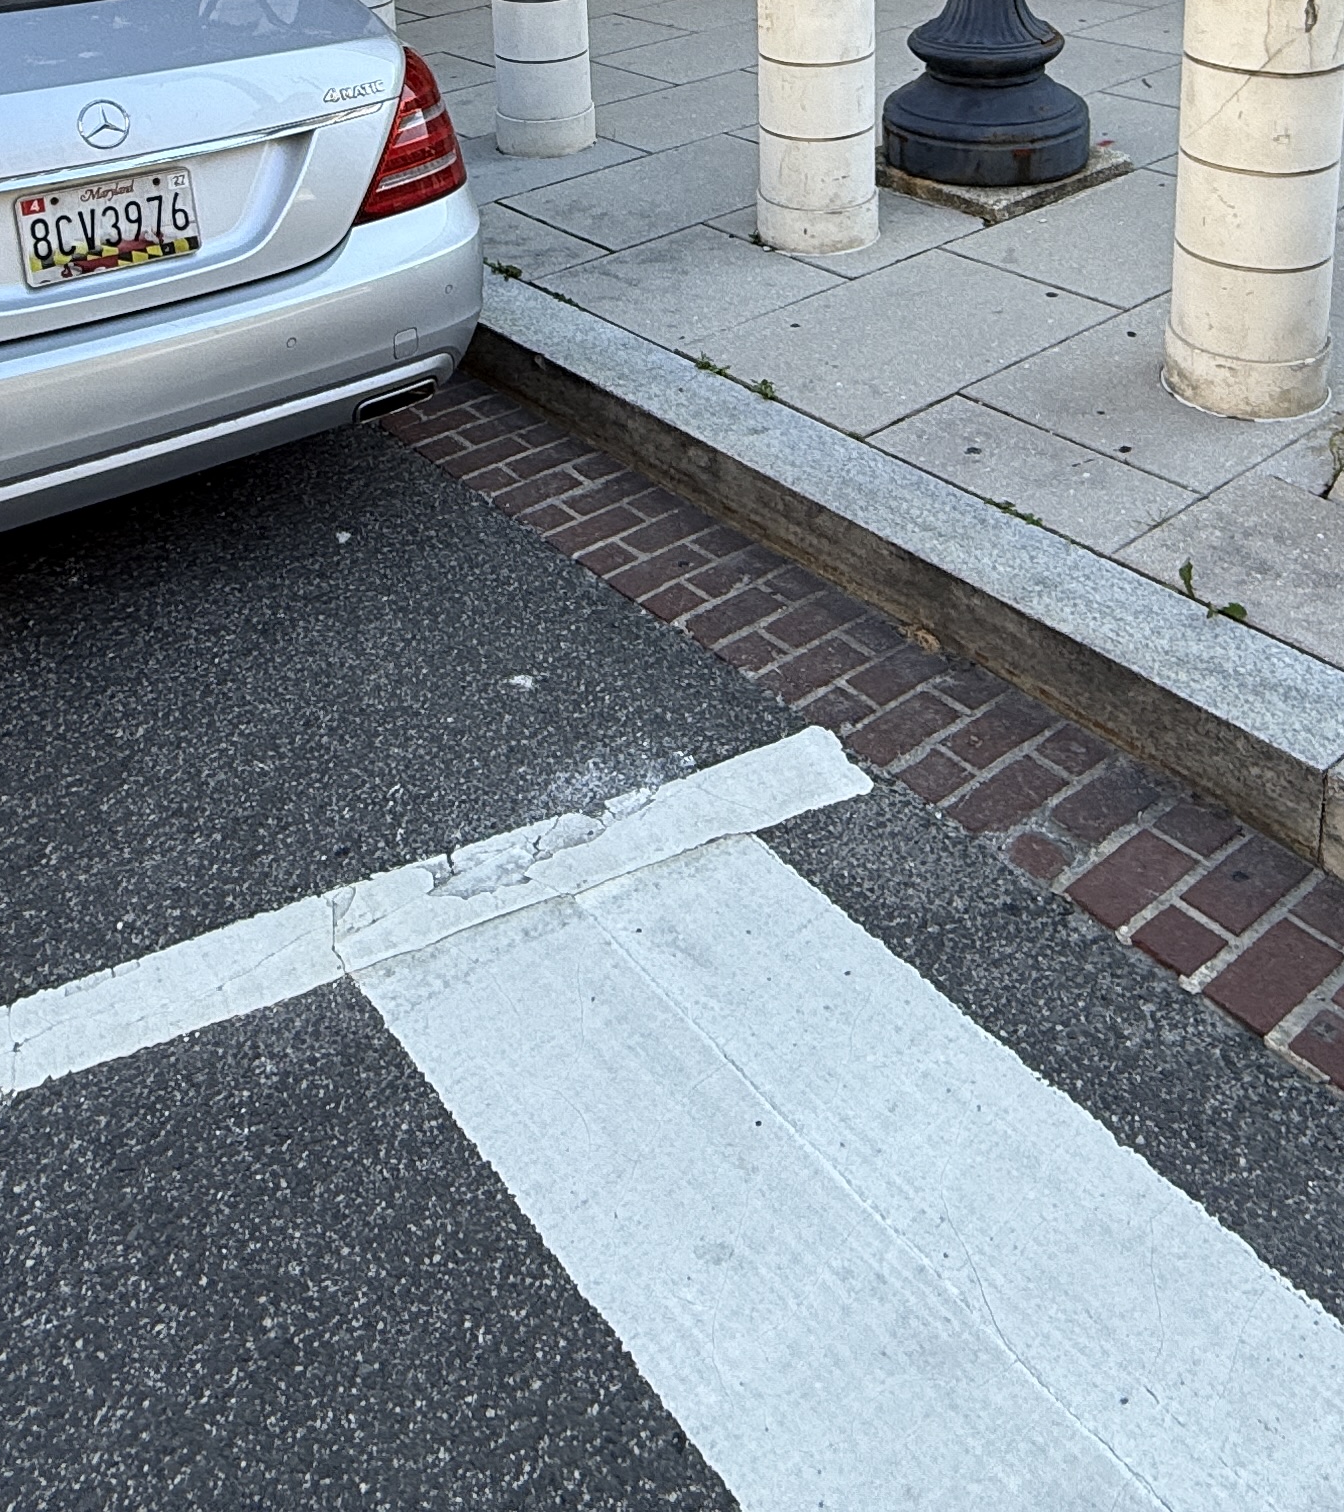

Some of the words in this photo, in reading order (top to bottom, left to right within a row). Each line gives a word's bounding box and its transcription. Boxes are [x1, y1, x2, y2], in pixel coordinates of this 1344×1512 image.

[322, 79, 386, 103] 4MATIC
[80, 179, 135, 202] Maryland
[172, 174, 187, 187] 27
[30, 199, 40, 212] 4
[30, 191, 191, 261] 8CV3976
